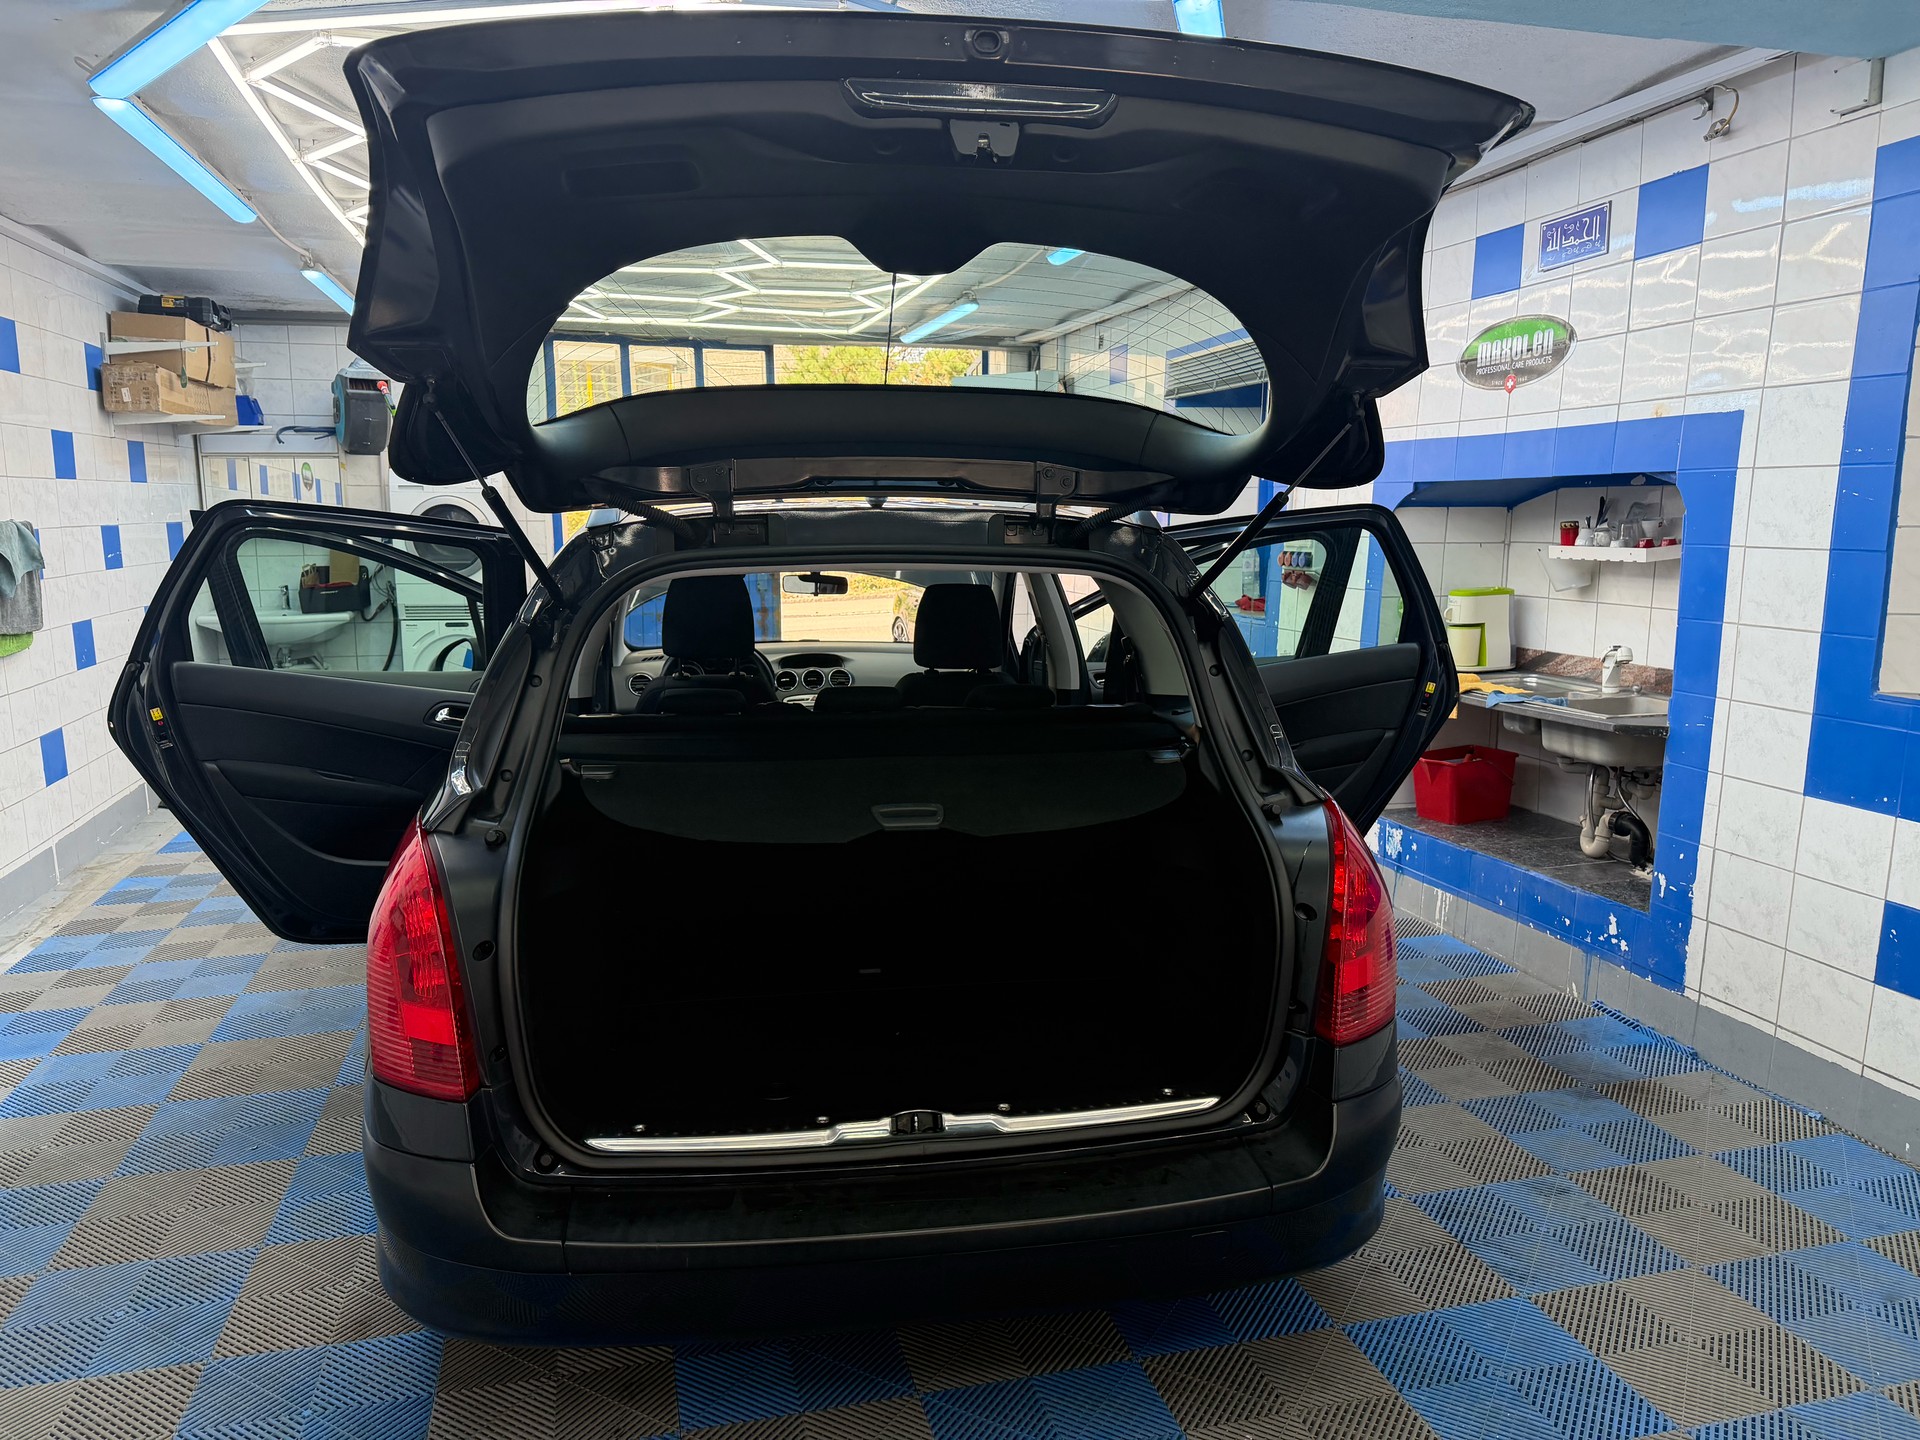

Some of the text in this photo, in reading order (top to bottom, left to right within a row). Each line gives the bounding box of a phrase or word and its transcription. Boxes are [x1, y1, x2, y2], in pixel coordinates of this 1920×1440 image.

[1476, 355, 1552, 375] PROFESSIONAL CARE PRODUCTS
